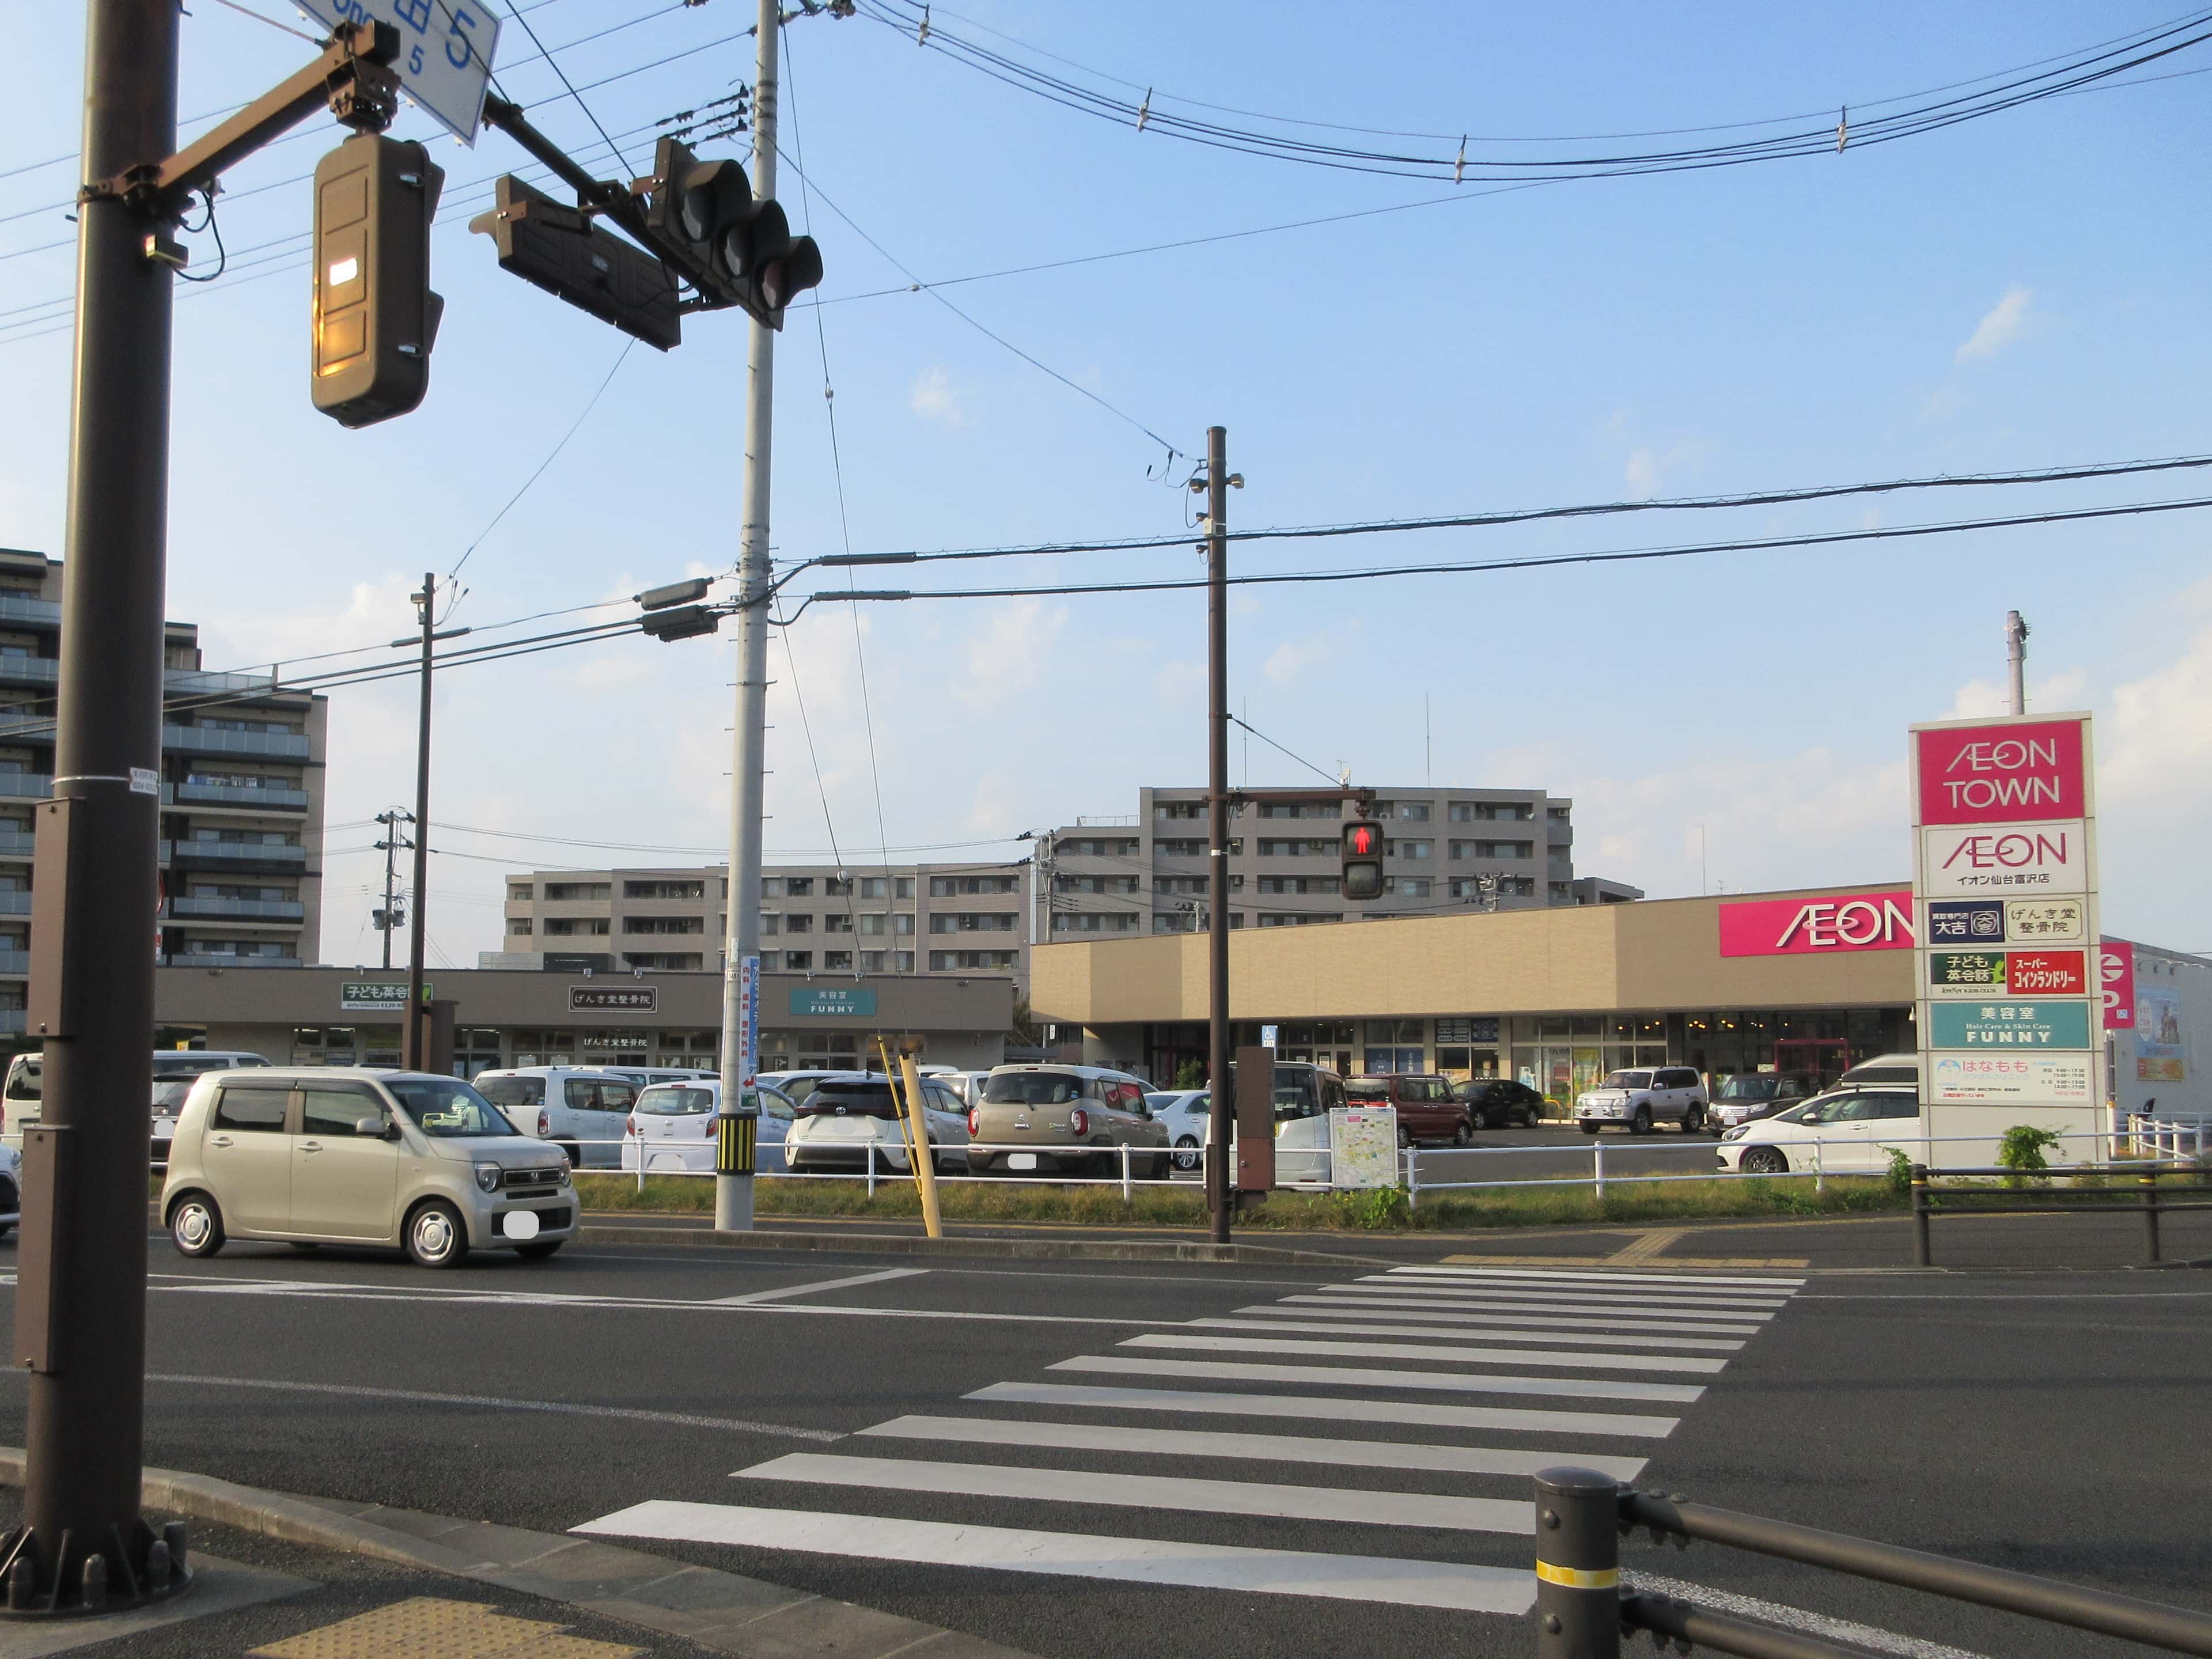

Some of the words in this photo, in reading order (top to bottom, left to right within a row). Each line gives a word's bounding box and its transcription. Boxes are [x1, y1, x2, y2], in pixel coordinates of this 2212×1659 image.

[1943, 776, 2060, 808] TOWN
[1957, 874, 2050, 885] イオン仙台富沢店
[2011, 908, 2077, 920] げんき堂
[1936, 922, 1967, 935] 大吉
[2019, 922, 2069, 934] 整骨院
[1946, 956, 1988, 968] 子ども
[2016, 959, 2048, 969] スーパー
[1946, 969, 1990, 982] 英会話
[2014, 971, 2076, 988] コインランドリー
[347, 986, 410, 999] 子ども英会
[819, 991, 847, 999] 美容室
[575, 995, 650, 1004] げんき堂整骨院
[1981, 1007, 2035, 1020] 美容室
[584, 1039, 648, 1047] げんき堂整骨院
[1966, 1031, 2051, 1043] FUNNY
[1963, 1060, 2028, 1073] はなもも
